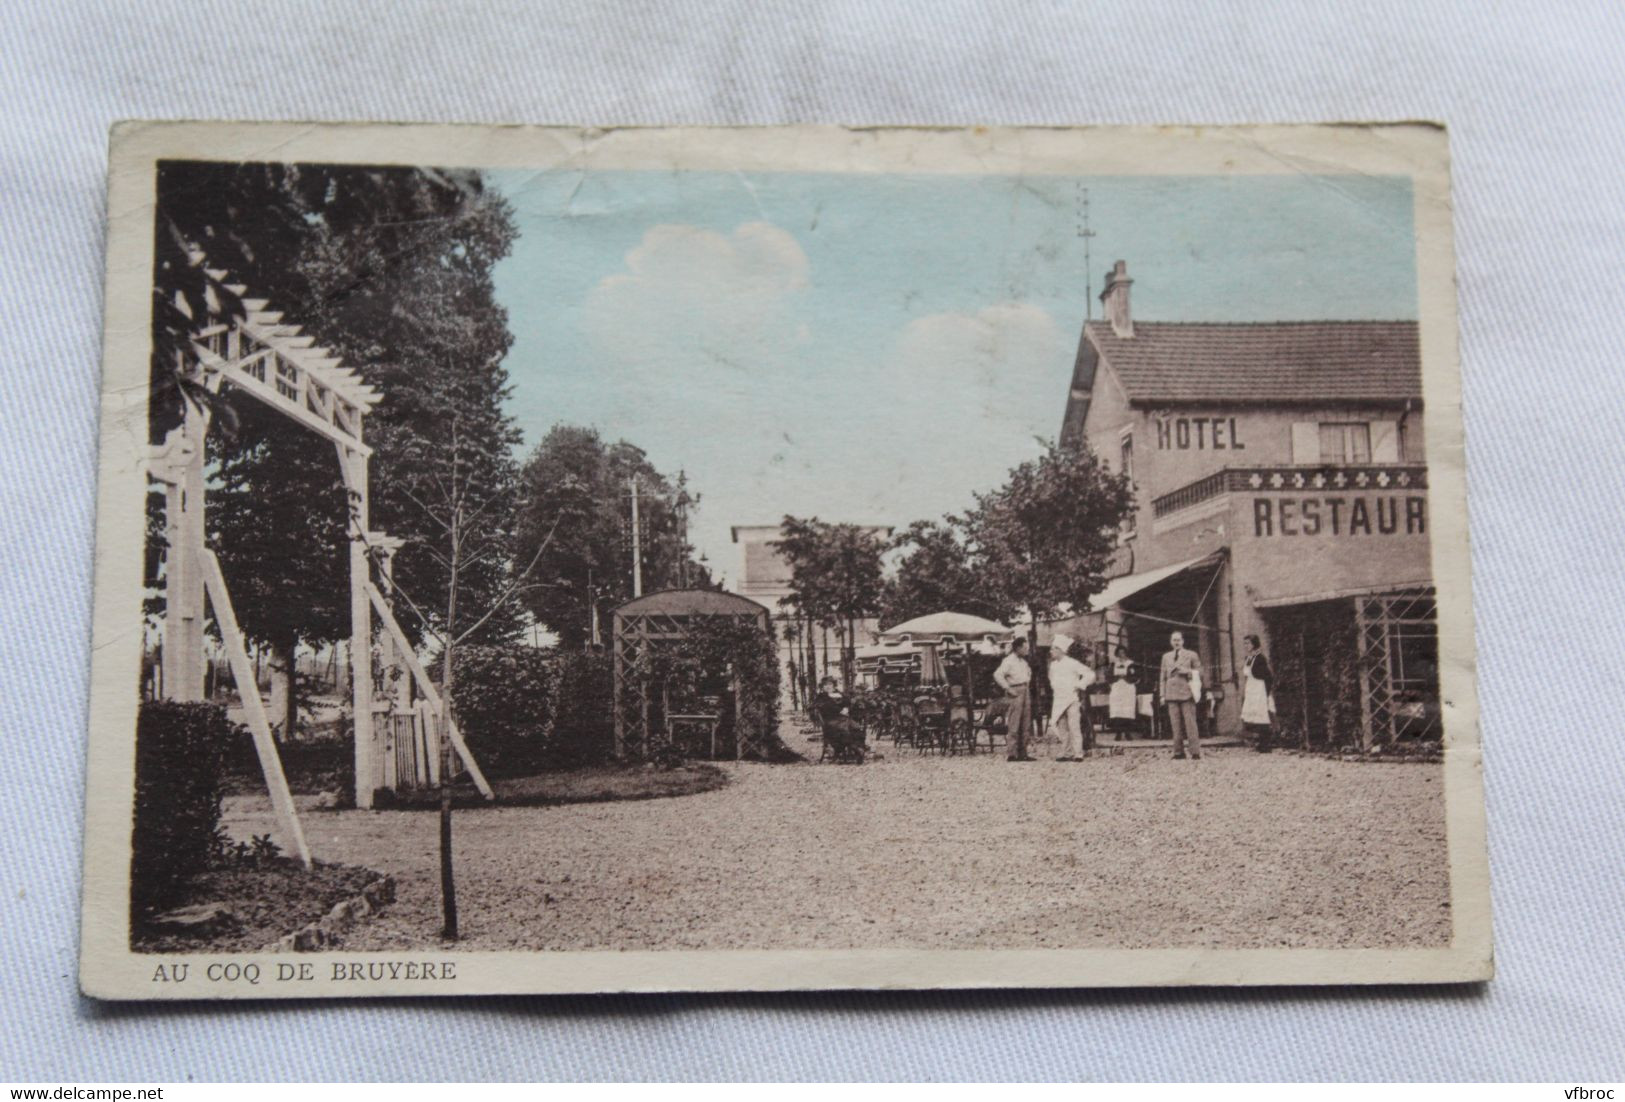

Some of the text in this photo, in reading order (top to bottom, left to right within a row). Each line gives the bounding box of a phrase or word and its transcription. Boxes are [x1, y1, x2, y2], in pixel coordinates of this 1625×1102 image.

[1254, 497, 1426, 537] RESTAUR
[152, 961, 457, 984] AU COQ DE BRUYÈRE
